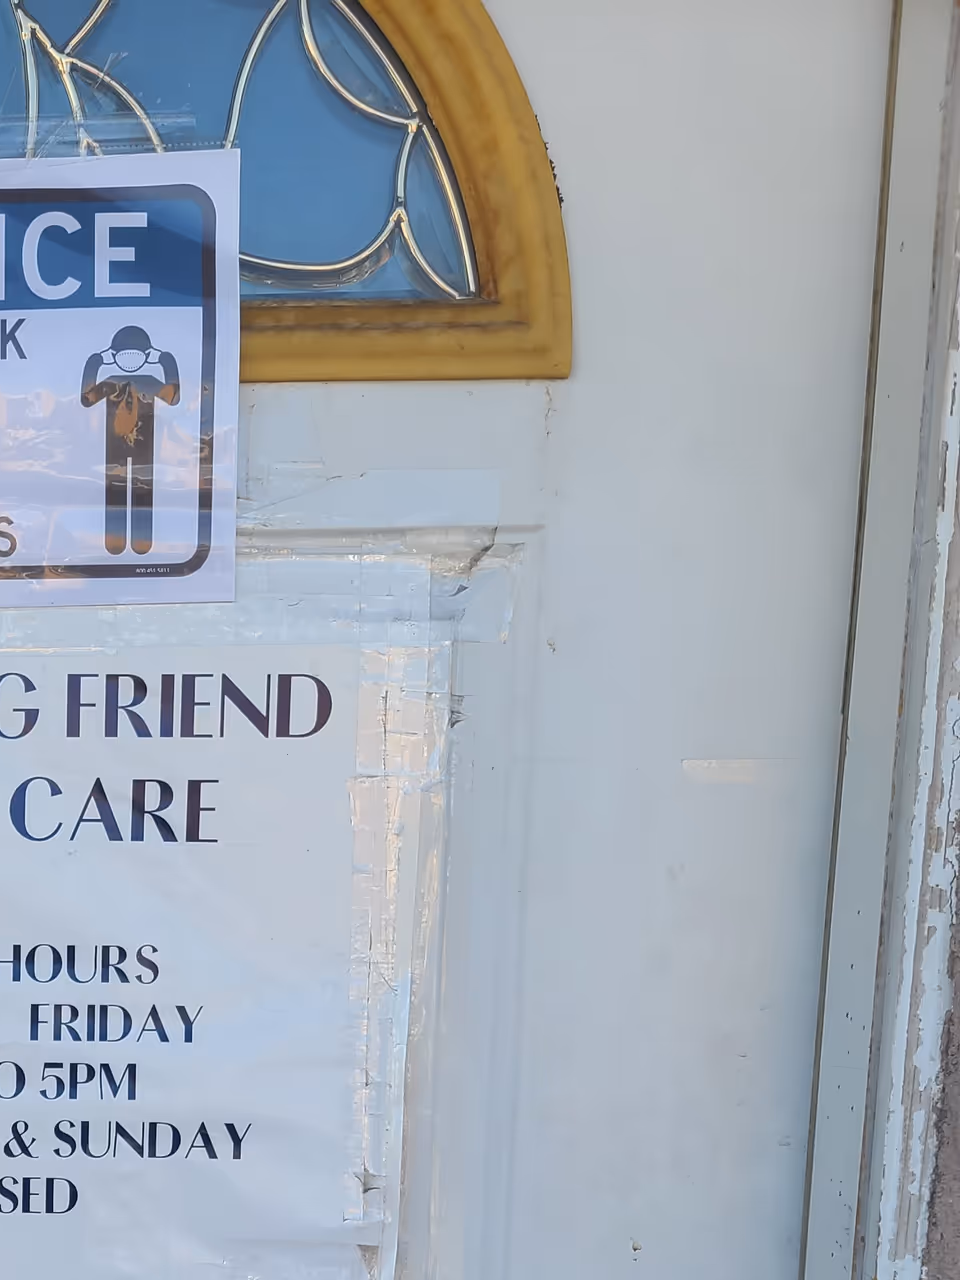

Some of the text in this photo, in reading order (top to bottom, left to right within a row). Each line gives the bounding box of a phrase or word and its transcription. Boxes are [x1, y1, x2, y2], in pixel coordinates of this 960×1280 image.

[66, 673, 333, 739] FRIEND
[9, 776, 220, 843] CARE
[29, 1003, 204, 1043] FRIDAY
[40, 1062, 137, 1101] 5PM
[3, 1120, 39, 1159] &
[52, 1120, 253, 1160] SUNDAY
